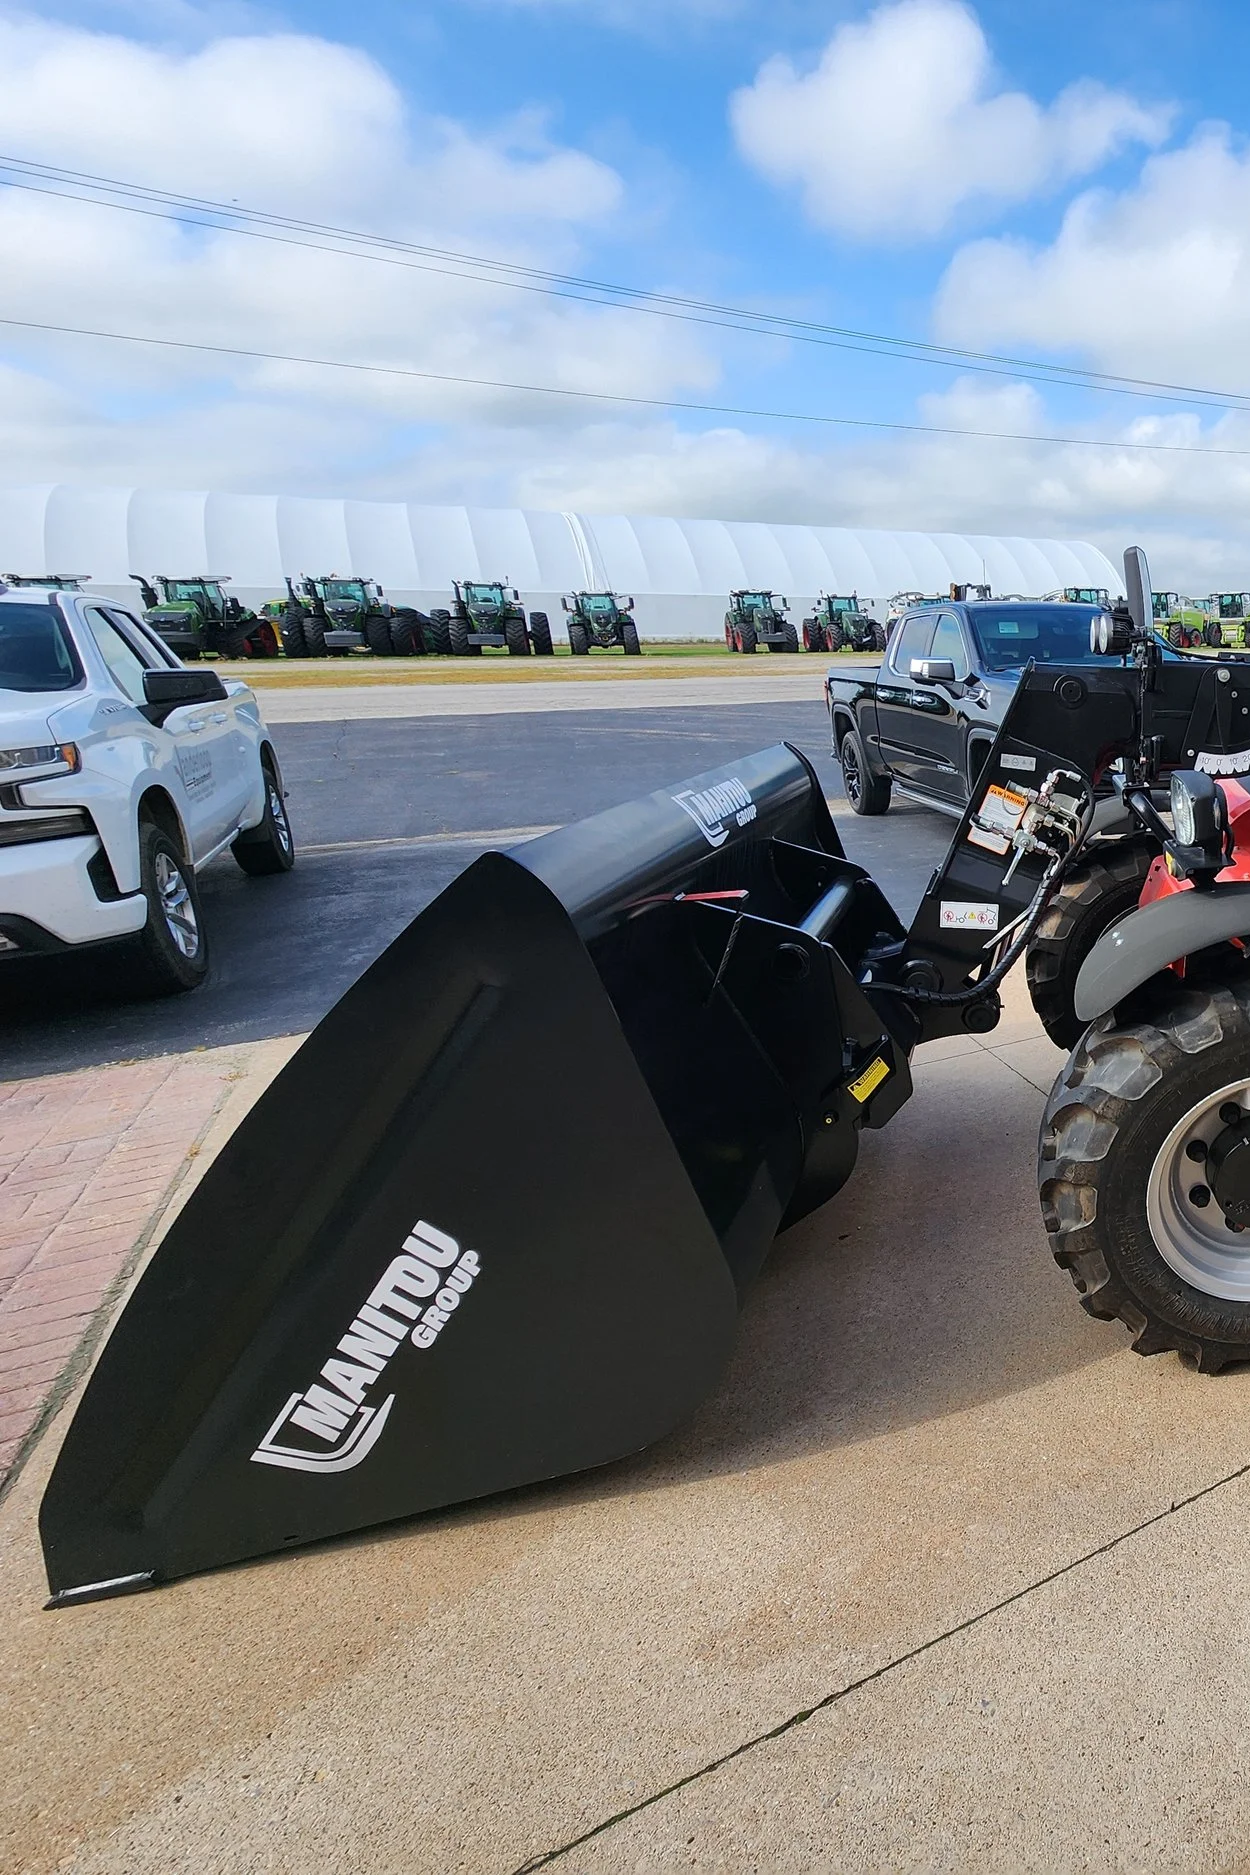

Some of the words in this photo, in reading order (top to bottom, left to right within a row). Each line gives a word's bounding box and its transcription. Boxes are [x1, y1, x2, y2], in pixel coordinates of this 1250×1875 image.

[689, 777, 752, 826] MANITOU
[735, 803, 757, 827] GROUP
[997, 790, 1026, 807] WARNING
[410, 1249, 481, 1349] GROUP
[289, 1219, 460, 1444] MANITOU
